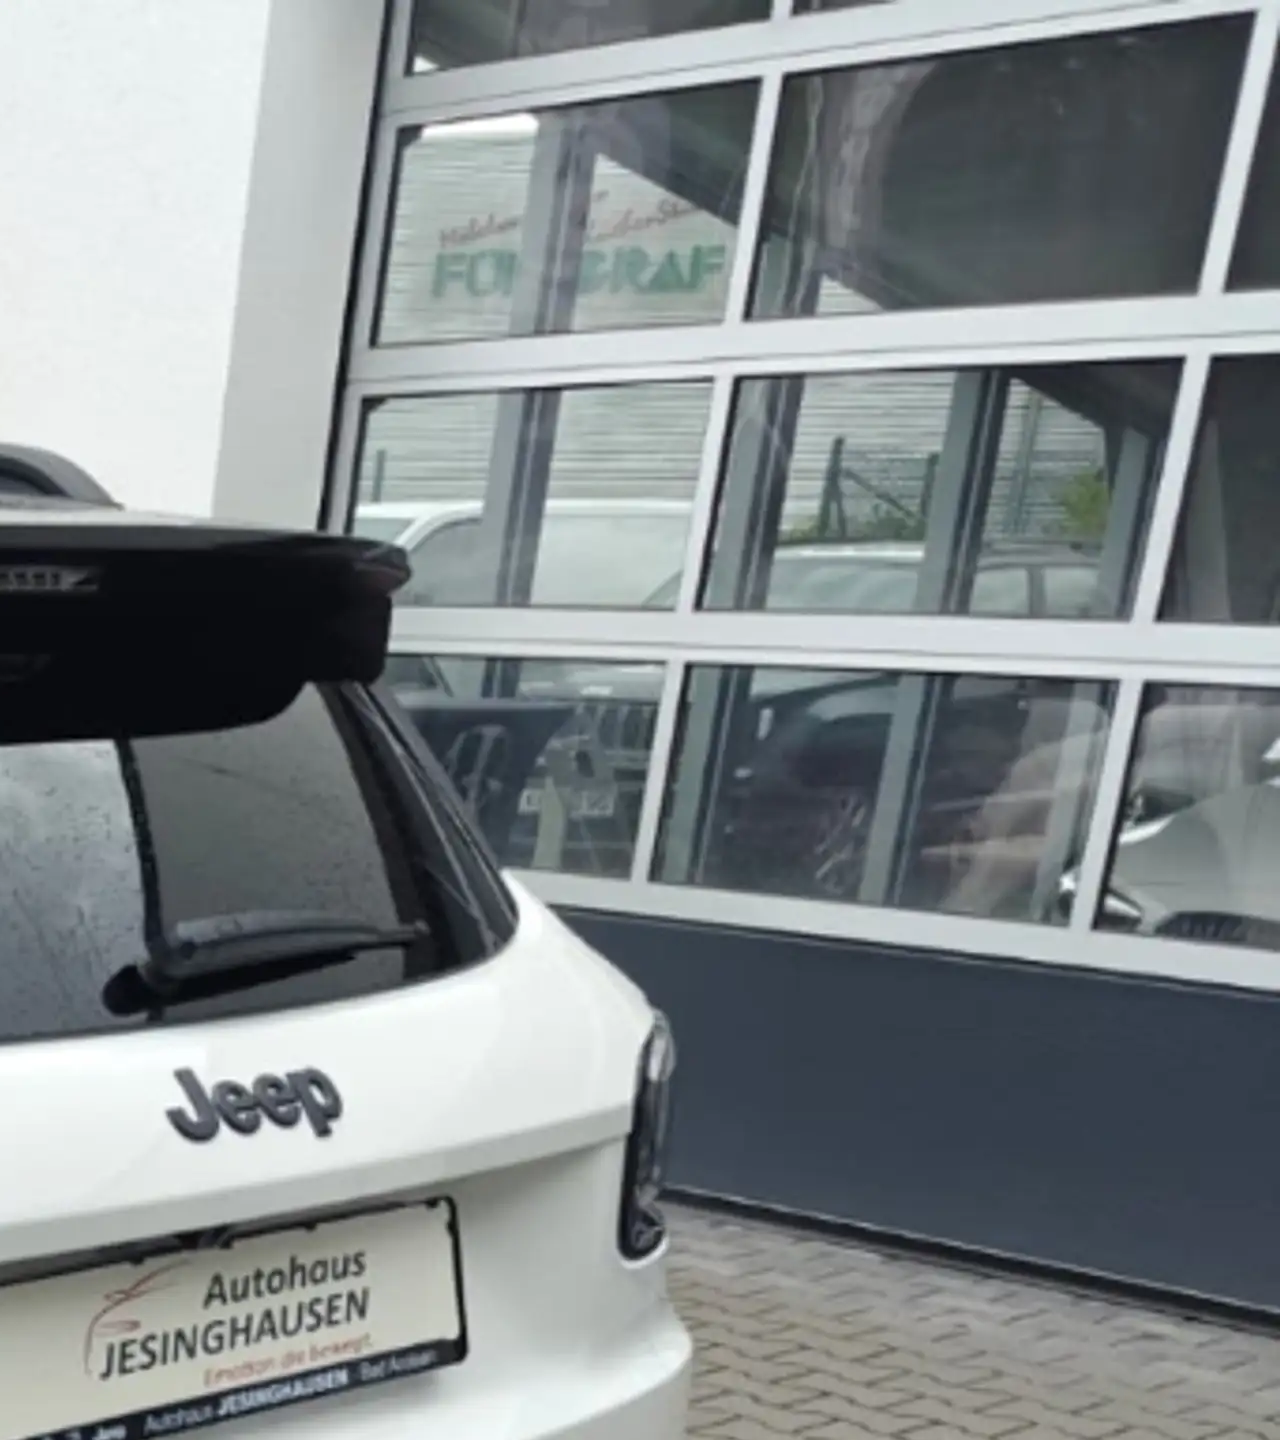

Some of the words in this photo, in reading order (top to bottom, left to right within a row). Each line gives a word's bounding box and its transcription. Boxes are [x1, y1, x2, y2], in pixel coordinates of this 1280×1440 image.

[165, 1065, 344, 1143] Jeep
[202, 1249, 367, 1310] Autohaus
[99, 1286, 371, 1382] JESINGHAUSEN
